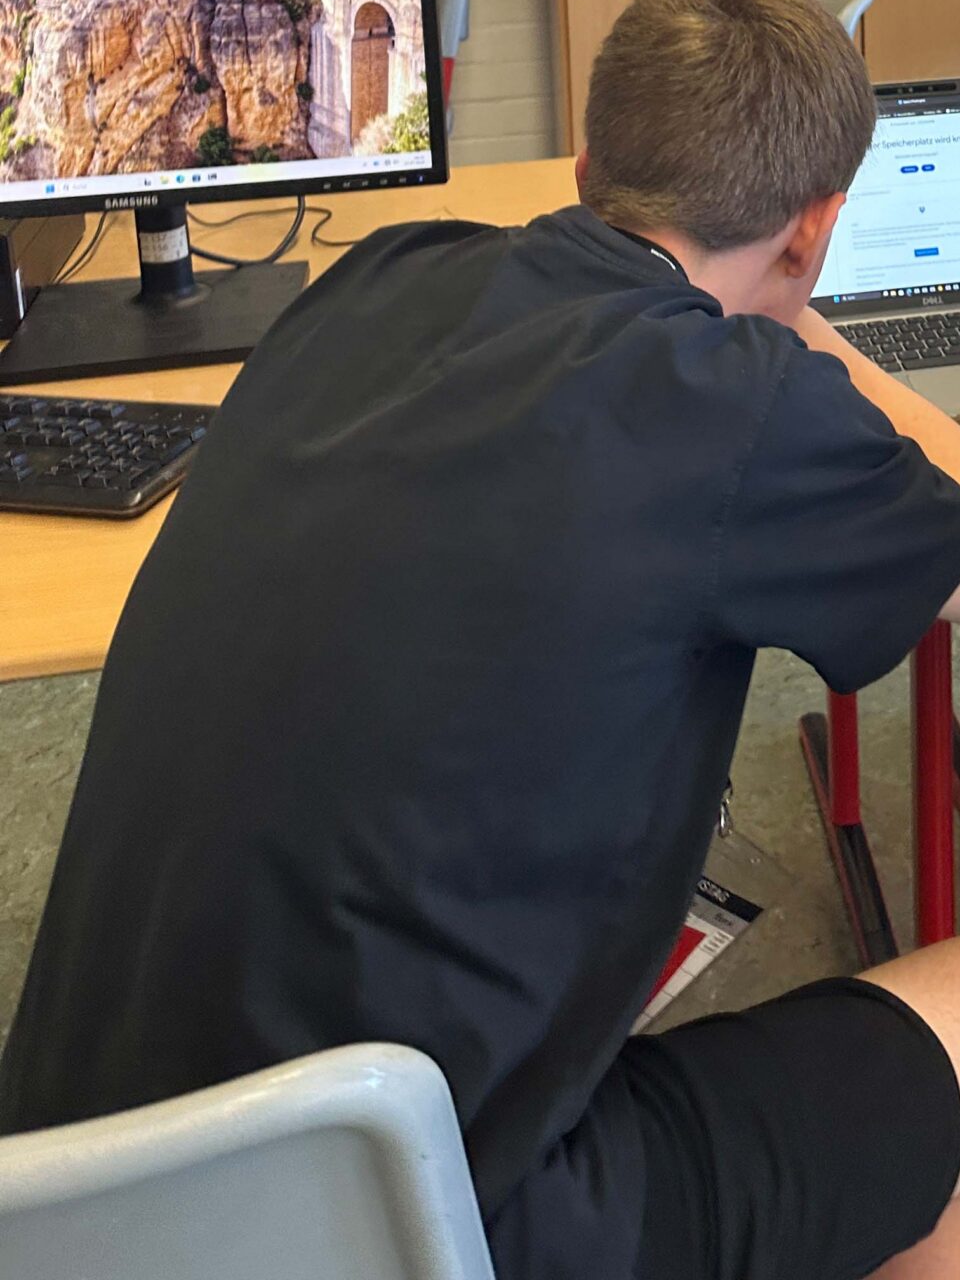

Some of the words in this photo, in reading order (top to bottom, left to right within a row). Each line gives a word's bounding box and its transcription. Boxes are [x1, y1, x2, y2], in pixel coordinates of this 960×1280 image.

[882, 137, 933, 151] Speicherplatz
[935, 135, 951, 145] wird
[105, 195, 158, 209] SAMSUNG
